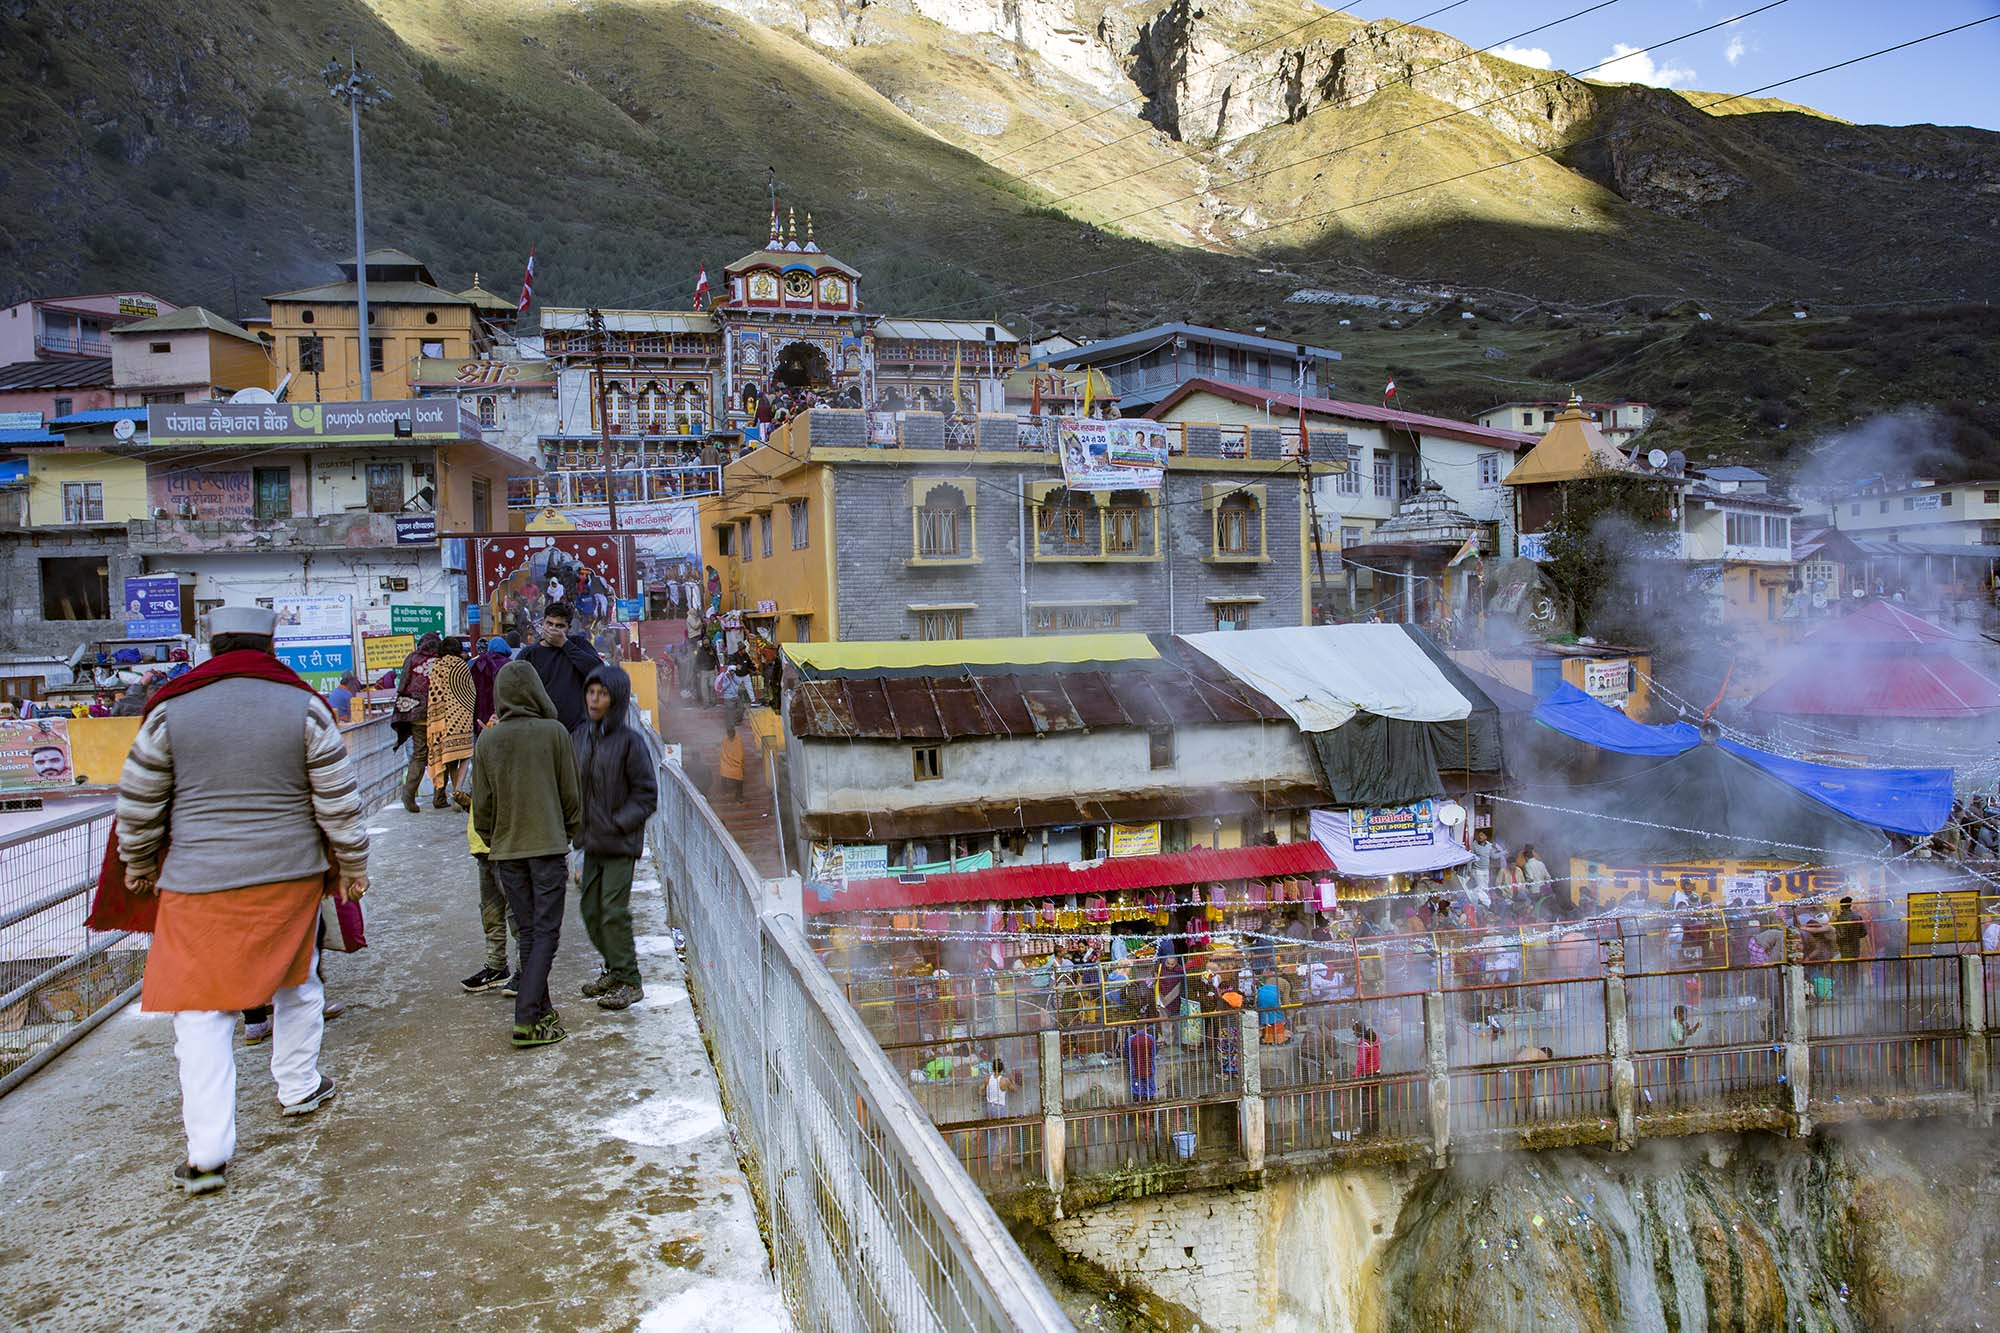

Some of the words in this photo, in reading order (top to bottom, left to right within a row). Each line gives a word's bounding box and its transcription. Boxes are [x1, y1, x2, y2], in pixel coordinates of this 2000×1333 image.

[166, 412, 206, 432] पंजाब
[209, 408, 259, 433] नैशनल
[263, 407, 288, 431] बैंक
[326, 409, 364, 429] punjab
[367, 408, 411, 425] national
[416, 408, 443, 422] bank
[1081, 435, 1089, 443] 24
[1097, 435, 1106, 443] 30
[298, 655, 307, 668] ए
[310, 649, 322, 666] टी
[325, 653, 342, 667] एम
